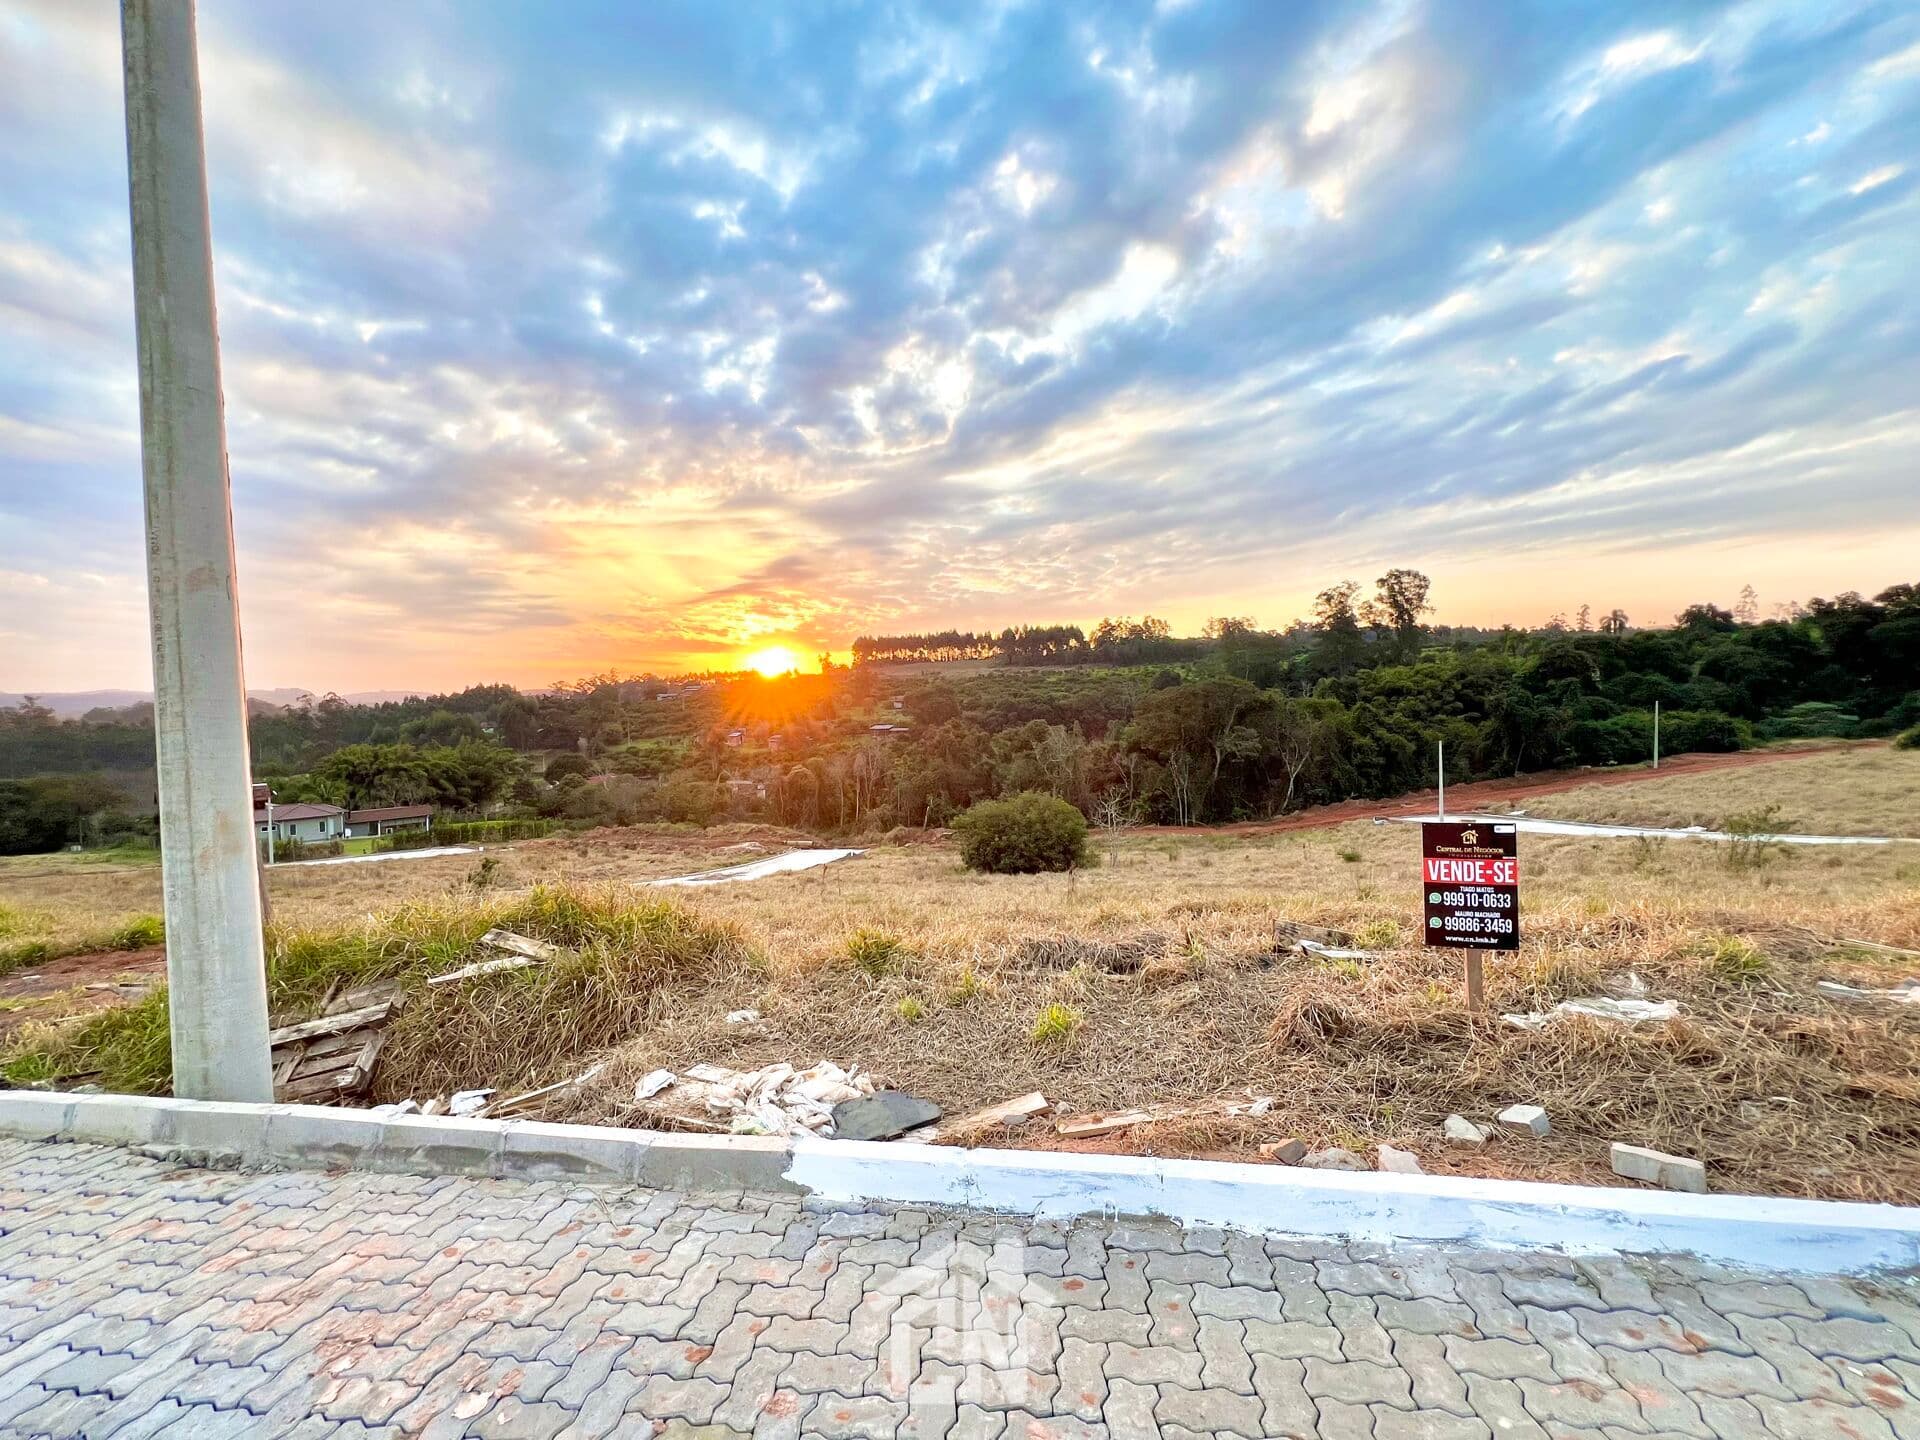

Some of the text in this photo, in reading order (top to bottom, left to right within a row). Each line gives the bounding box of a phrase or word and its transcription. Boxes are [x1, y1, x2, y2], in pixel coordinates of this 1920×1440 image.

[1462, 834, 1477, 845] CN
[1436, 845, 1463, 853] CENTRAL
[1428, 859, 1515, 883] VENDE-SE
[1443, 891, 1511, 908] 99910-0633
[1444, 916, 1513, 933] 99886-3459
[1445, 935, 1499, 944] www.cn.imb.br
